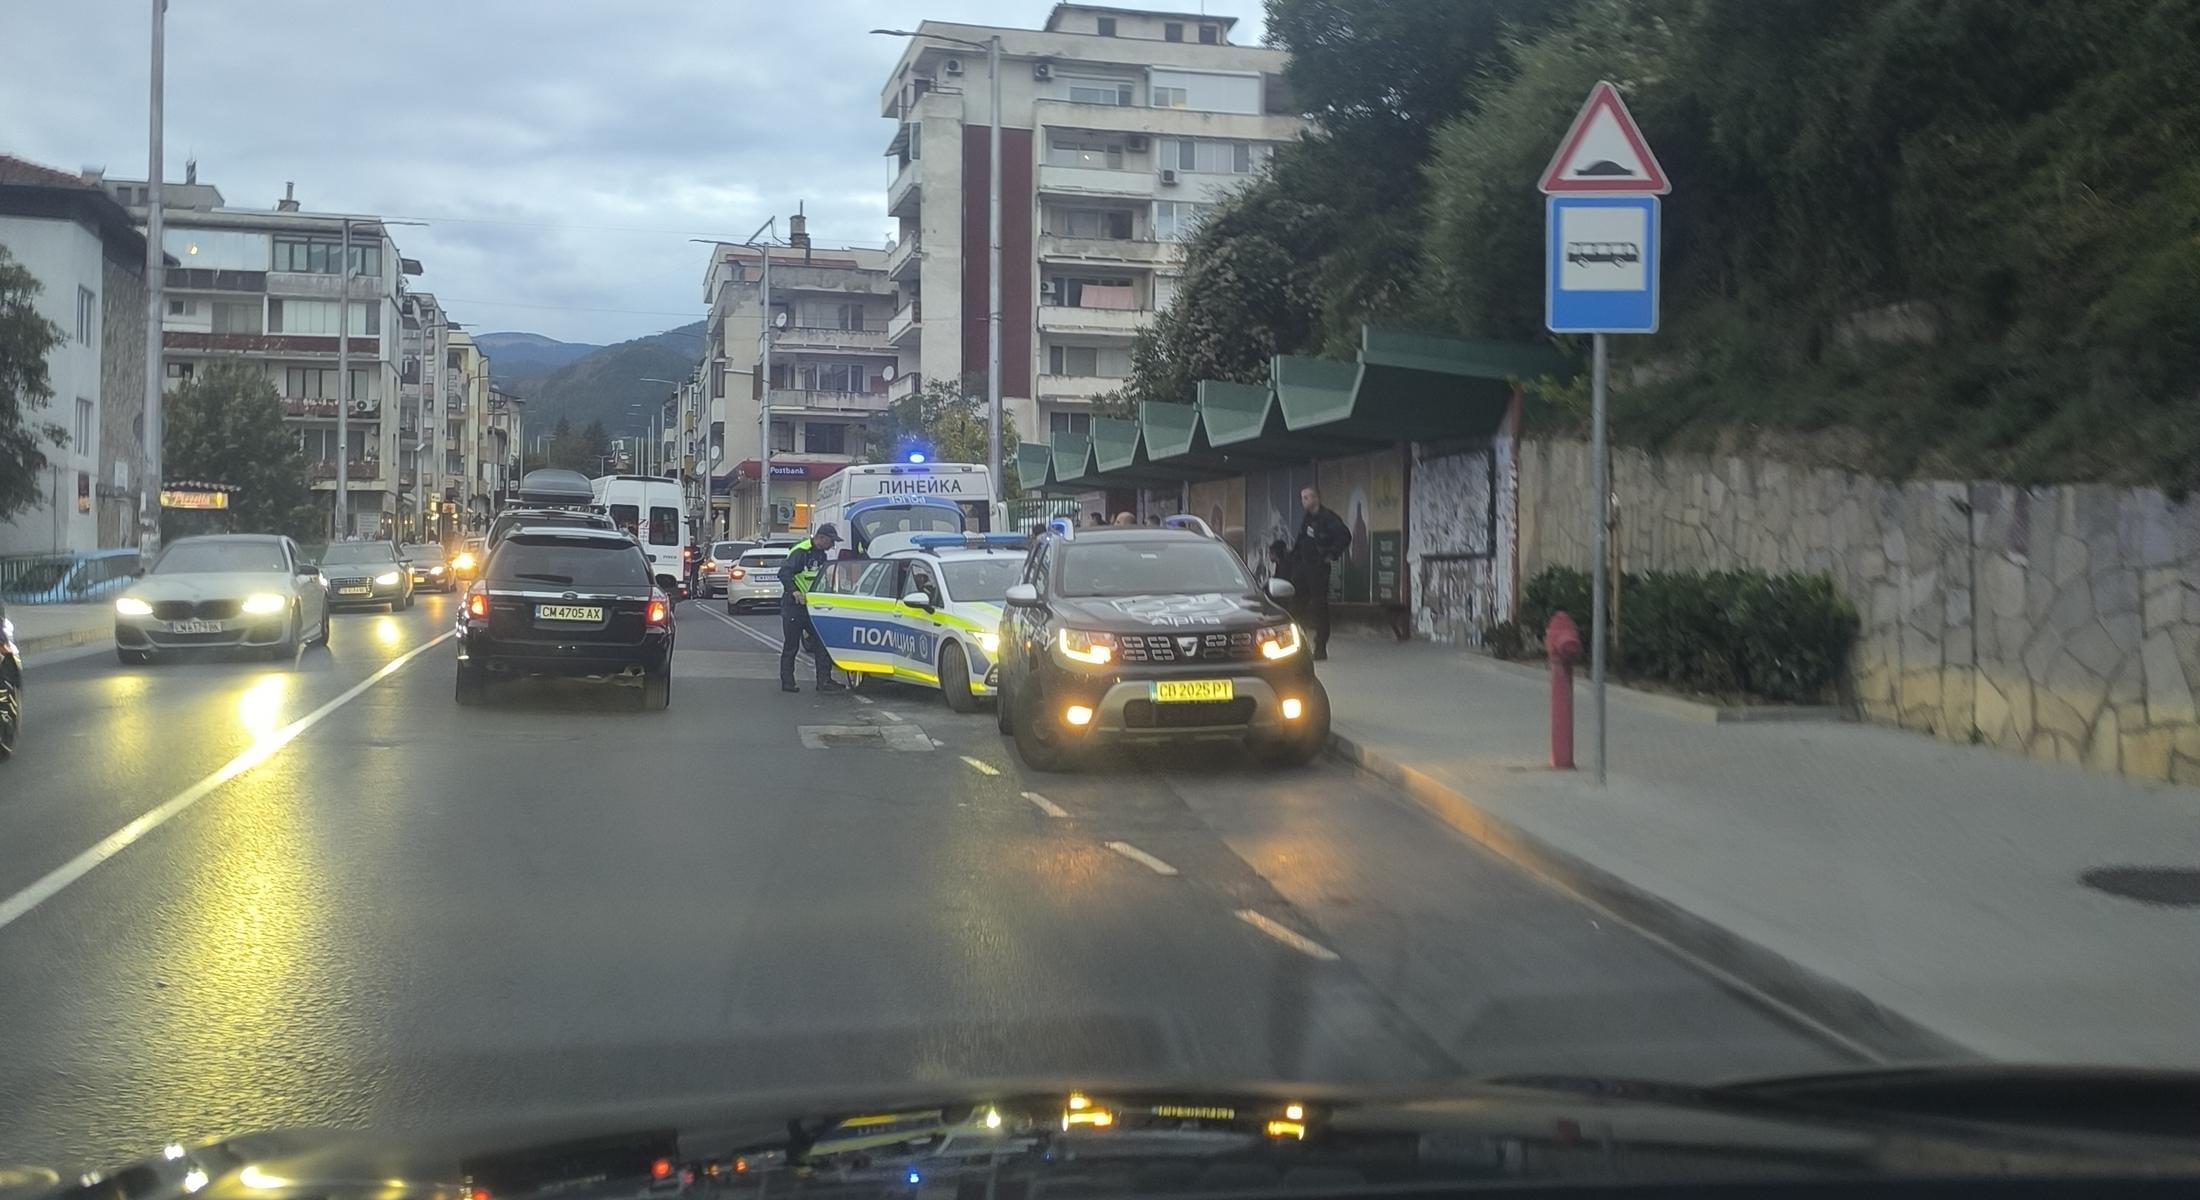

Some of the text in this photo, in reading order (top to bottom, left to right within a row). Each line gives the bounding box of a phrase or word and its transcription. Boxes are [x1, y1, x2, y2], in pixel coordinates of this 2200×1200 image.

[770, 466, 804, 474] Postbank
[878, 476, 962, 494] ЛИНЕЙКА
[542, 606, 601, 619] CM 4705 AX
[852, 626, 916, 653] ПОЛИЦИЯ
[1160, 681, 1230, 698] CB 2025 PT
